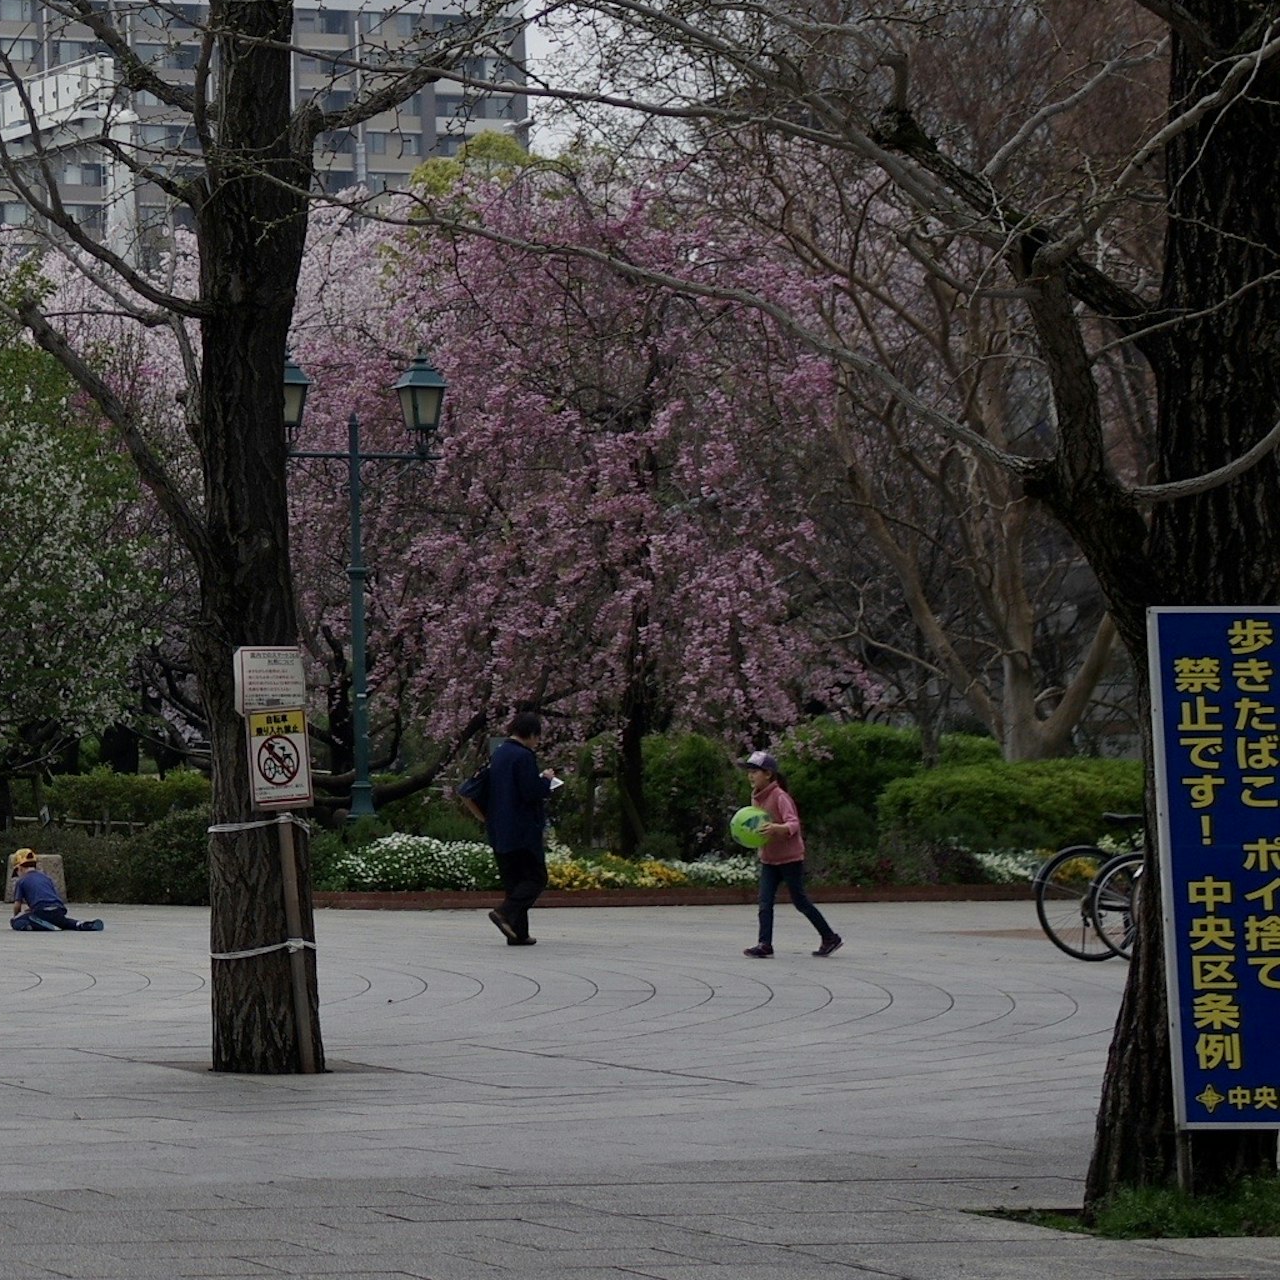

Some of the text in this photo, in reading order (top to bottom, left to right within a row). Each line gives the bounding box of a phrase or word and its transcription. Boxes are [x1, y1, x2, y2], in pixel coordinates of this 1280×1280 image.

[266, 714, 288, 724] 自転車
[1227, 619, 1279, 808] 歩きたばこ
[255, 724, 300, 736] 乗り入れ禁止
[1187, 875, 1242, 1070] 中央区条例
[1228, 1086, 1279, 1110] 中央
